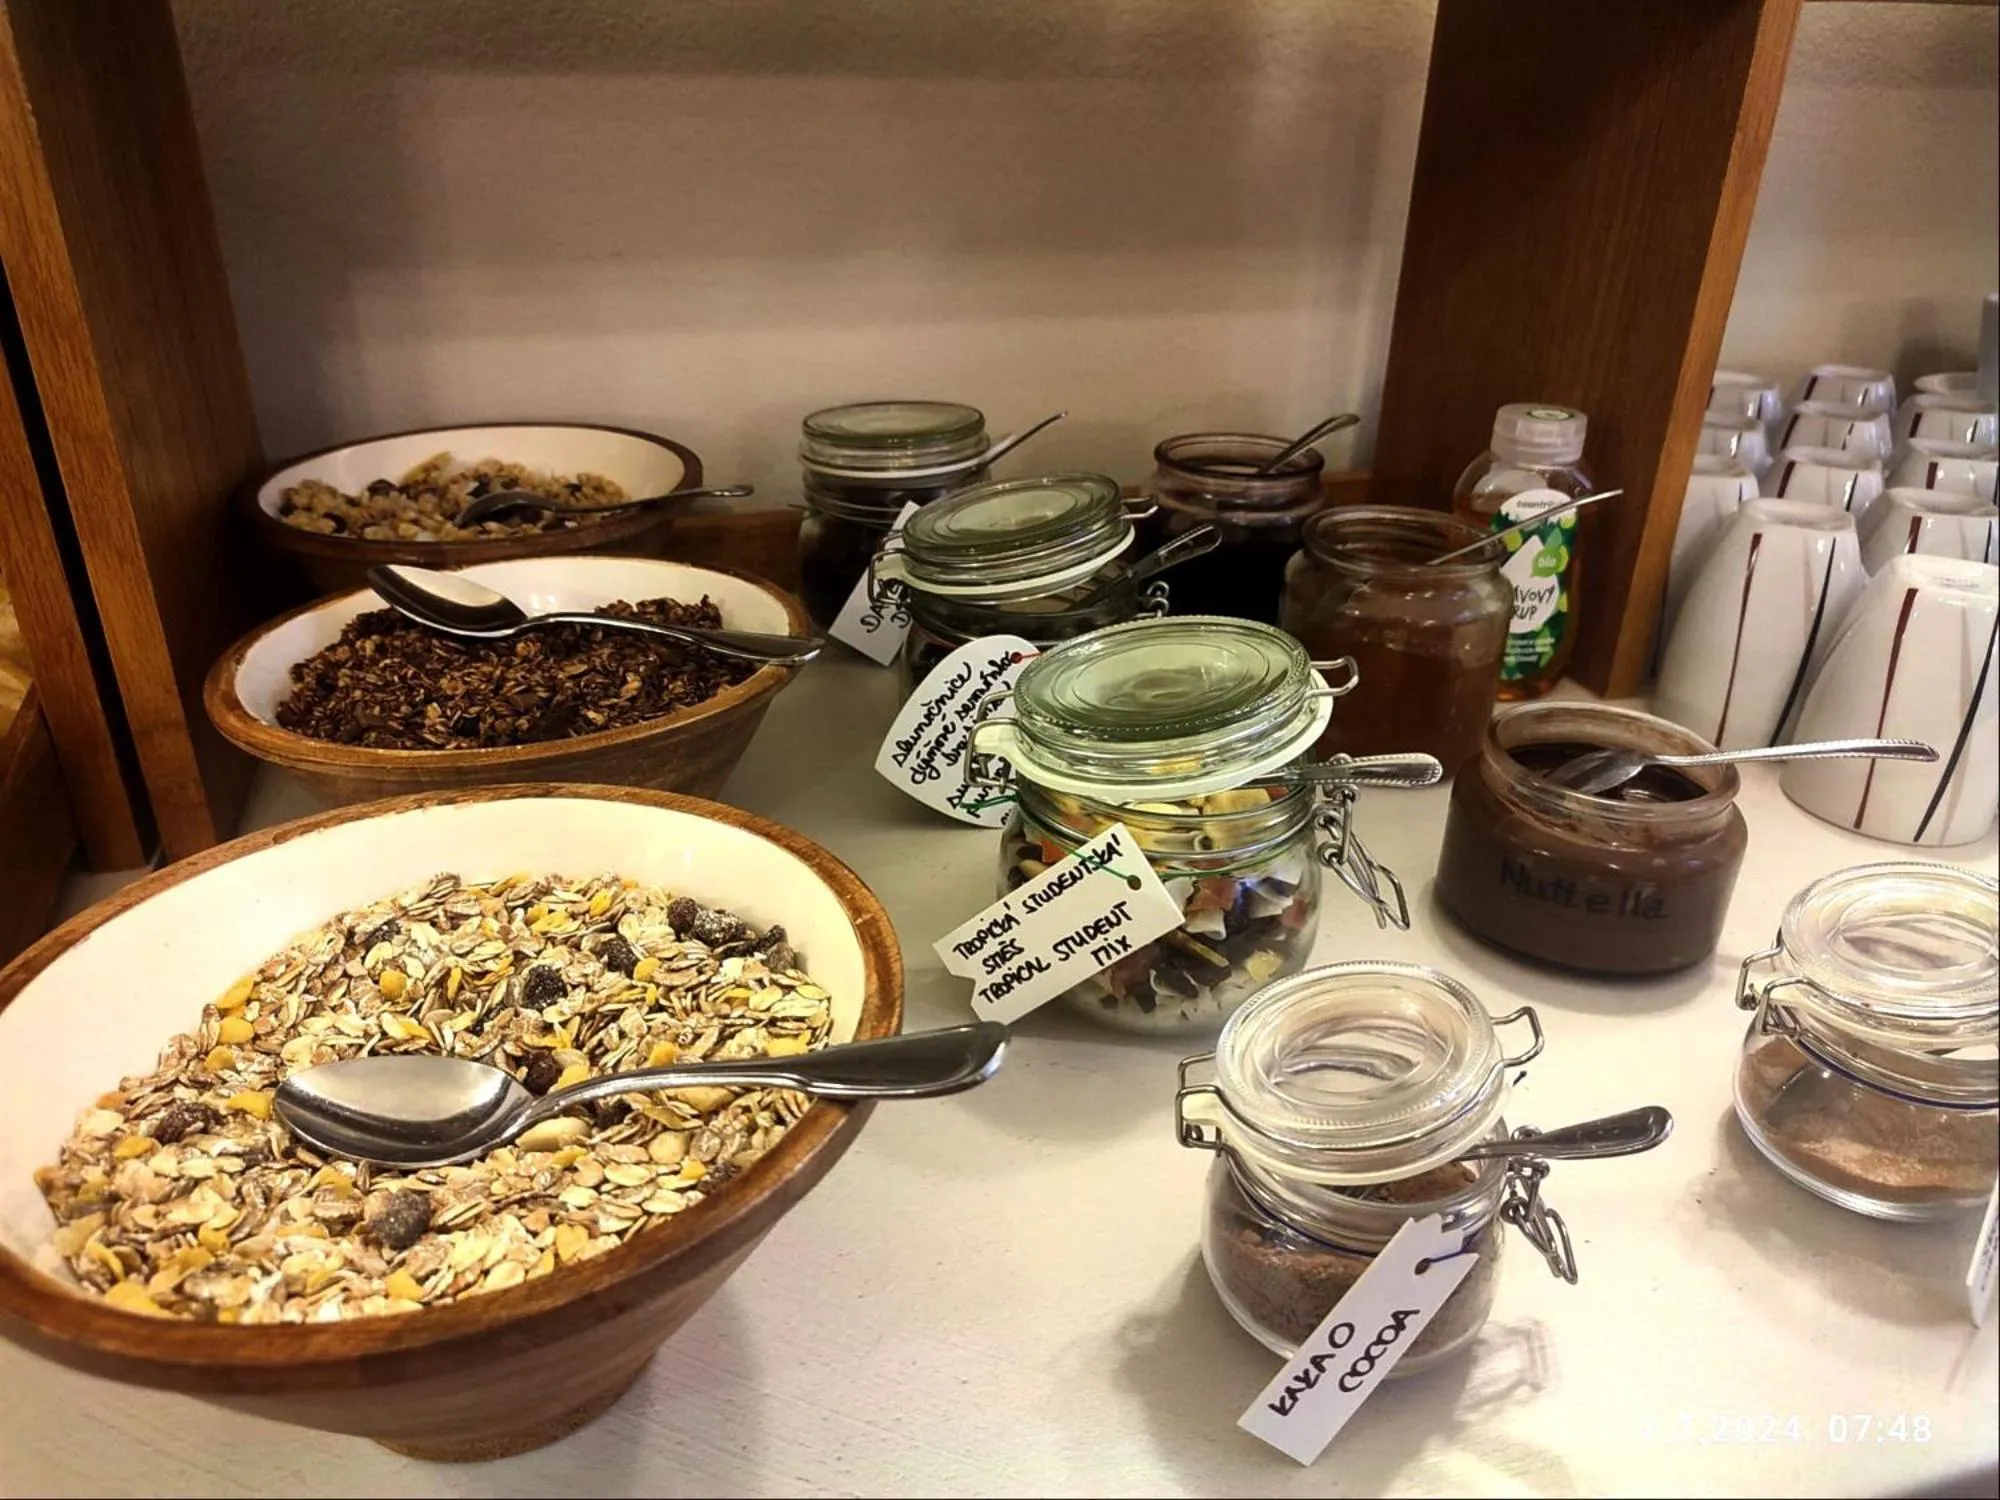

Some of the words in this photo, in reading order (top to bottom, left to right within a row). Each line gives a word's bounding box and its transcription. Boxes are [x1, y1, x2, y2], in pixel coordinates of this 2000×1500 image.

[1512, 605, 1538, 621] RUP
[1052, 900, 1133, 961] STUDENT
[1268, 1322, 1355, 1416] KAKAO
[1338, 1309, 1421, 1393] COCOA
